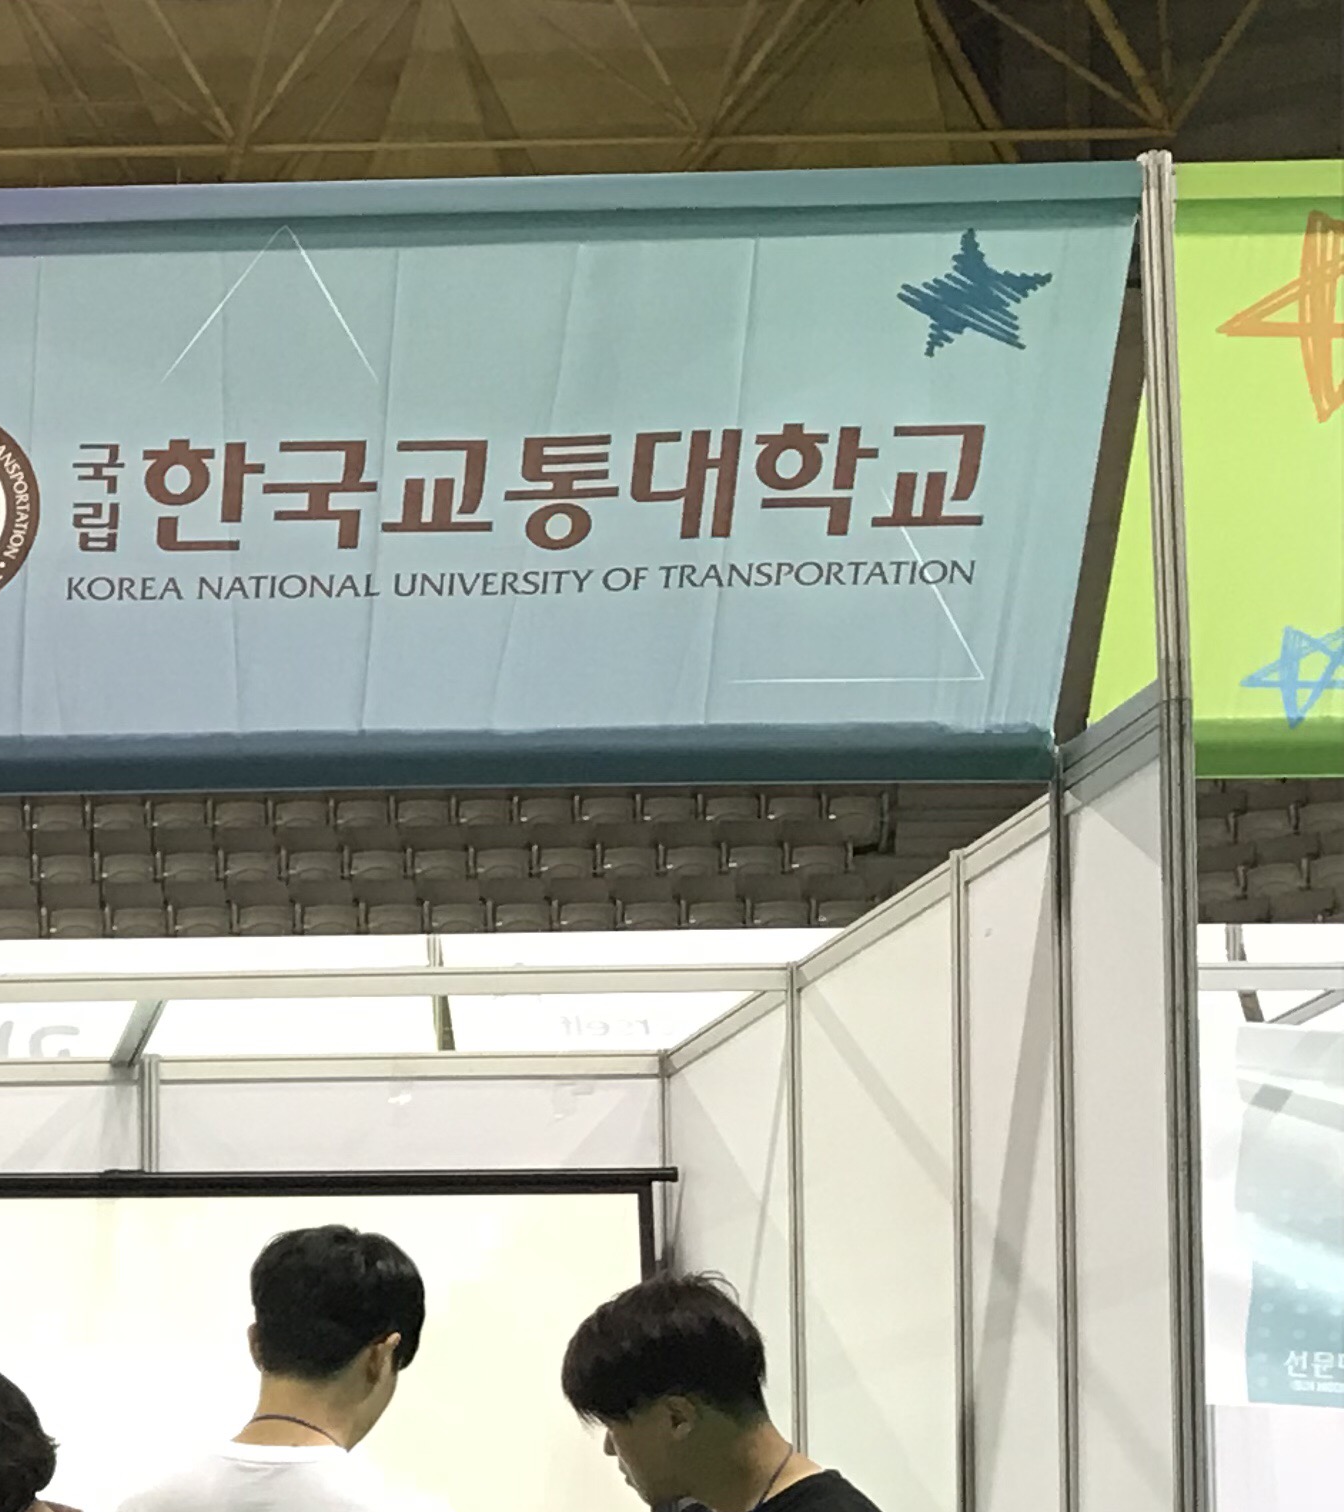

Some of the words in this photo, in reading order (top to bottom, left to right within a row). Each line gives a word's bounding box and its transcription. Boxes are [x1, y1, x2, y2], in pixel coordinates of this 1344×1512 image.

[72, 443, 125, 552] 국립
[142, 423, 986, 552] 한국교통대학교
[66, 576, 184, 601] KOREA
[197, 573, 380, 600] NATIONAL
[394, 568, 595, 598] UNIVERSITY
[602, 566, 649, 593] OF
[659, 559, 976, 590] TRANSPORTATION
[1283, 1350, 1344, 1379] 선문
